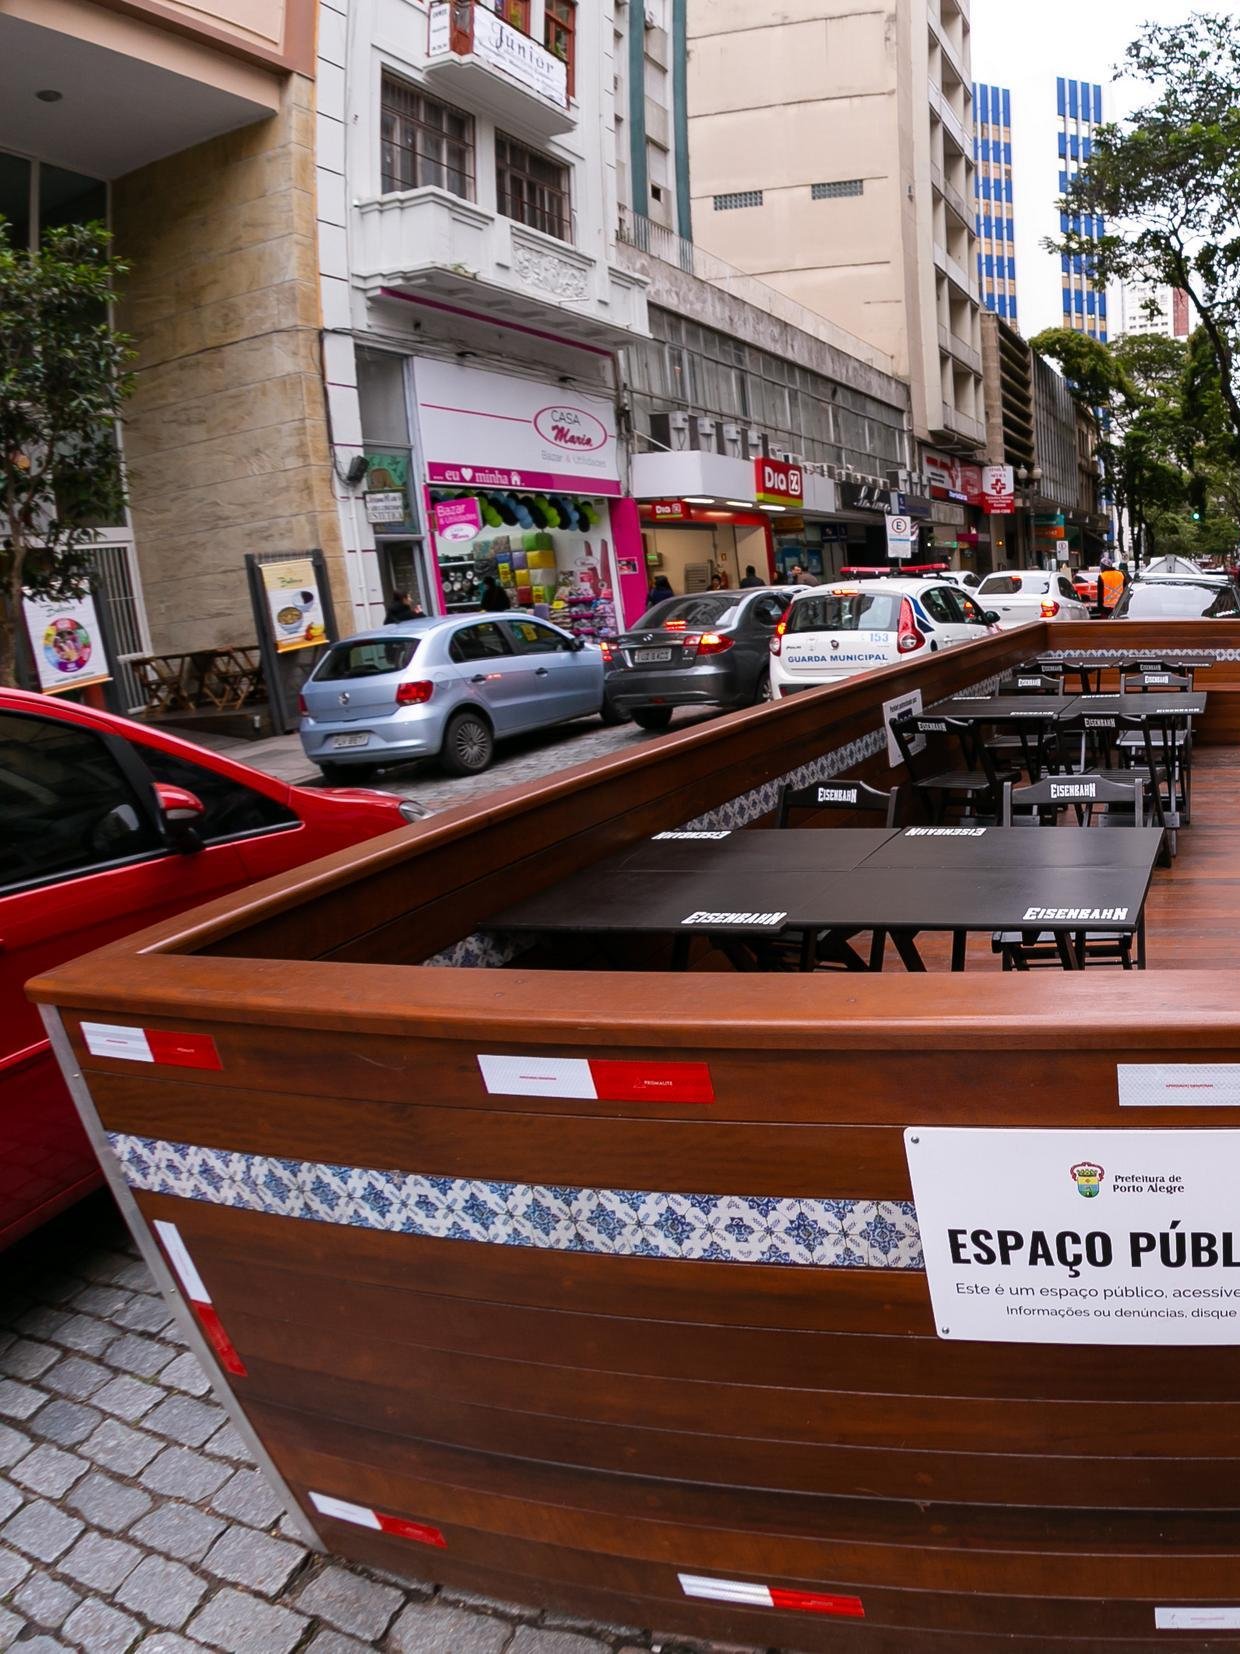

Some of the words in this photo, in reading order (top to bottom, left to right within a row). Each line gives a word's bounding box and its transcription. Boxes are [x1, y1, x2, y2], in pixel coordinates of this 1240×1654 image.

[551, 410, 581, 426] CASA
[552, 425, 593, 447] Maria
[445, 470, 460, 481] eu
[475, 470, 509, 485] minha
[437, 504, 466, 516] Bazar
[870, 633, 889, 642] 153
[788, 654, 827, 663] GUARDA
[829, 653, 888, 662] MUNICIPAL
[1084, 717, 1116, 728] EISENBAHN
[817, 787, 858, 804] EISENBAHN
[1050, 783, 1097, 799] EISENBAHN
[905, 827, 987, 838] EISENBAHN
[681, 911, 788, 926] EISENBAHN
[1022, 906, 1129, 922] EISENBAHN
[1114, 1174, 1166, 1184] Prefeitura
[1168, 1174, 1182, 1183] de
[1112, 1184, 1144, 1193] Porto
[1147, 1183, 1185, 1194] Alegre
[947, 1228, 1113, 1278] ESPAÇO
[956, 1282, 991, 1295] Este
[995, 1283, 1005, 1296] é
[1009, 1287, 1035, 1296] um
[1040, 1287, 1099, 1300] espaço
[1103, 1285, 1168, 1300] público,
[1006, 1305, 1090, 1319] Informações
[1094, 1309, 1111, 1318] ou
[1114, 1307, 1188, 1319] denúncias,
[1191, 1307, 1238, 1319] disque
